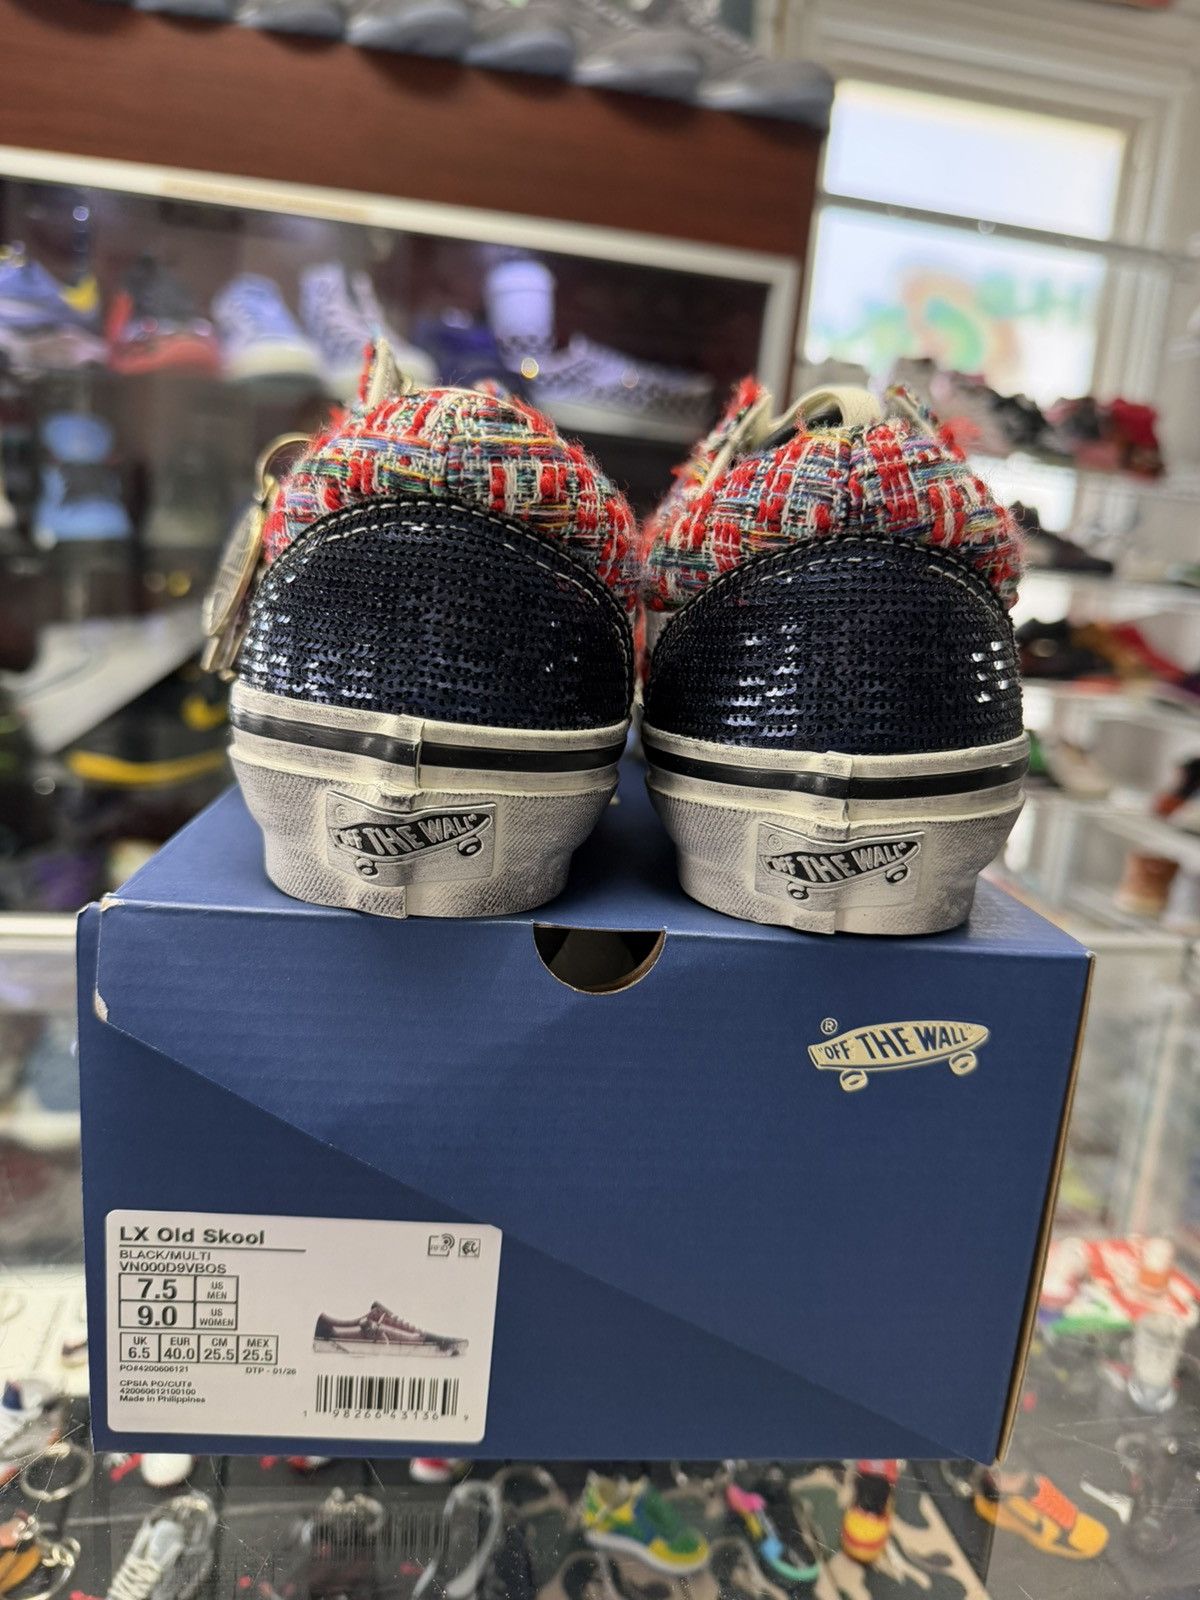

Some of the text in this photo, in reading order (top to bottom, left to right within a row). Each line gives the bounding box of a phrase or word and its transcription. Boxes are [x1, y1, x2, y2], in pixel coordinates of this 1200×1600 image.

[363, 826, 424, 855] THE
[796, 854, 857, 882] THE
[855, 1027, 915, 1059] THE
[119, 1226, 264, 1245] LX Old Skool
[119, 1250, 211, 1261] BLACK/MULTI
[137, 1278, 177, 1299] 7.5
[211, 1281, 224, 1290] US
[206, 1291, 228, 1300] MEN
[137, 1305, 178, 1326] 9.0
[210, 1307, 223, 1316] US
[199, 1317, 234, 1327] WOMEN
[133, 1337, 147, 1345] UK
[170, 1337, 190, 1346] EUR
[211, 1338, 228, 1347] CM
[247, 1338, 270, 1348] MEX
[128, 1347, 150, 1359] 6.5
[164, 1347, 195, 1360] 40.0
[204, 1348, 235, 1361] 25.5
[242, 1349, 273, 1361] 25.5
[245, 1367, 264, 1375] DTP
[119, 1380, 148, 1388] CPSIA
[157, 1395, 206, 1404] Philippines
